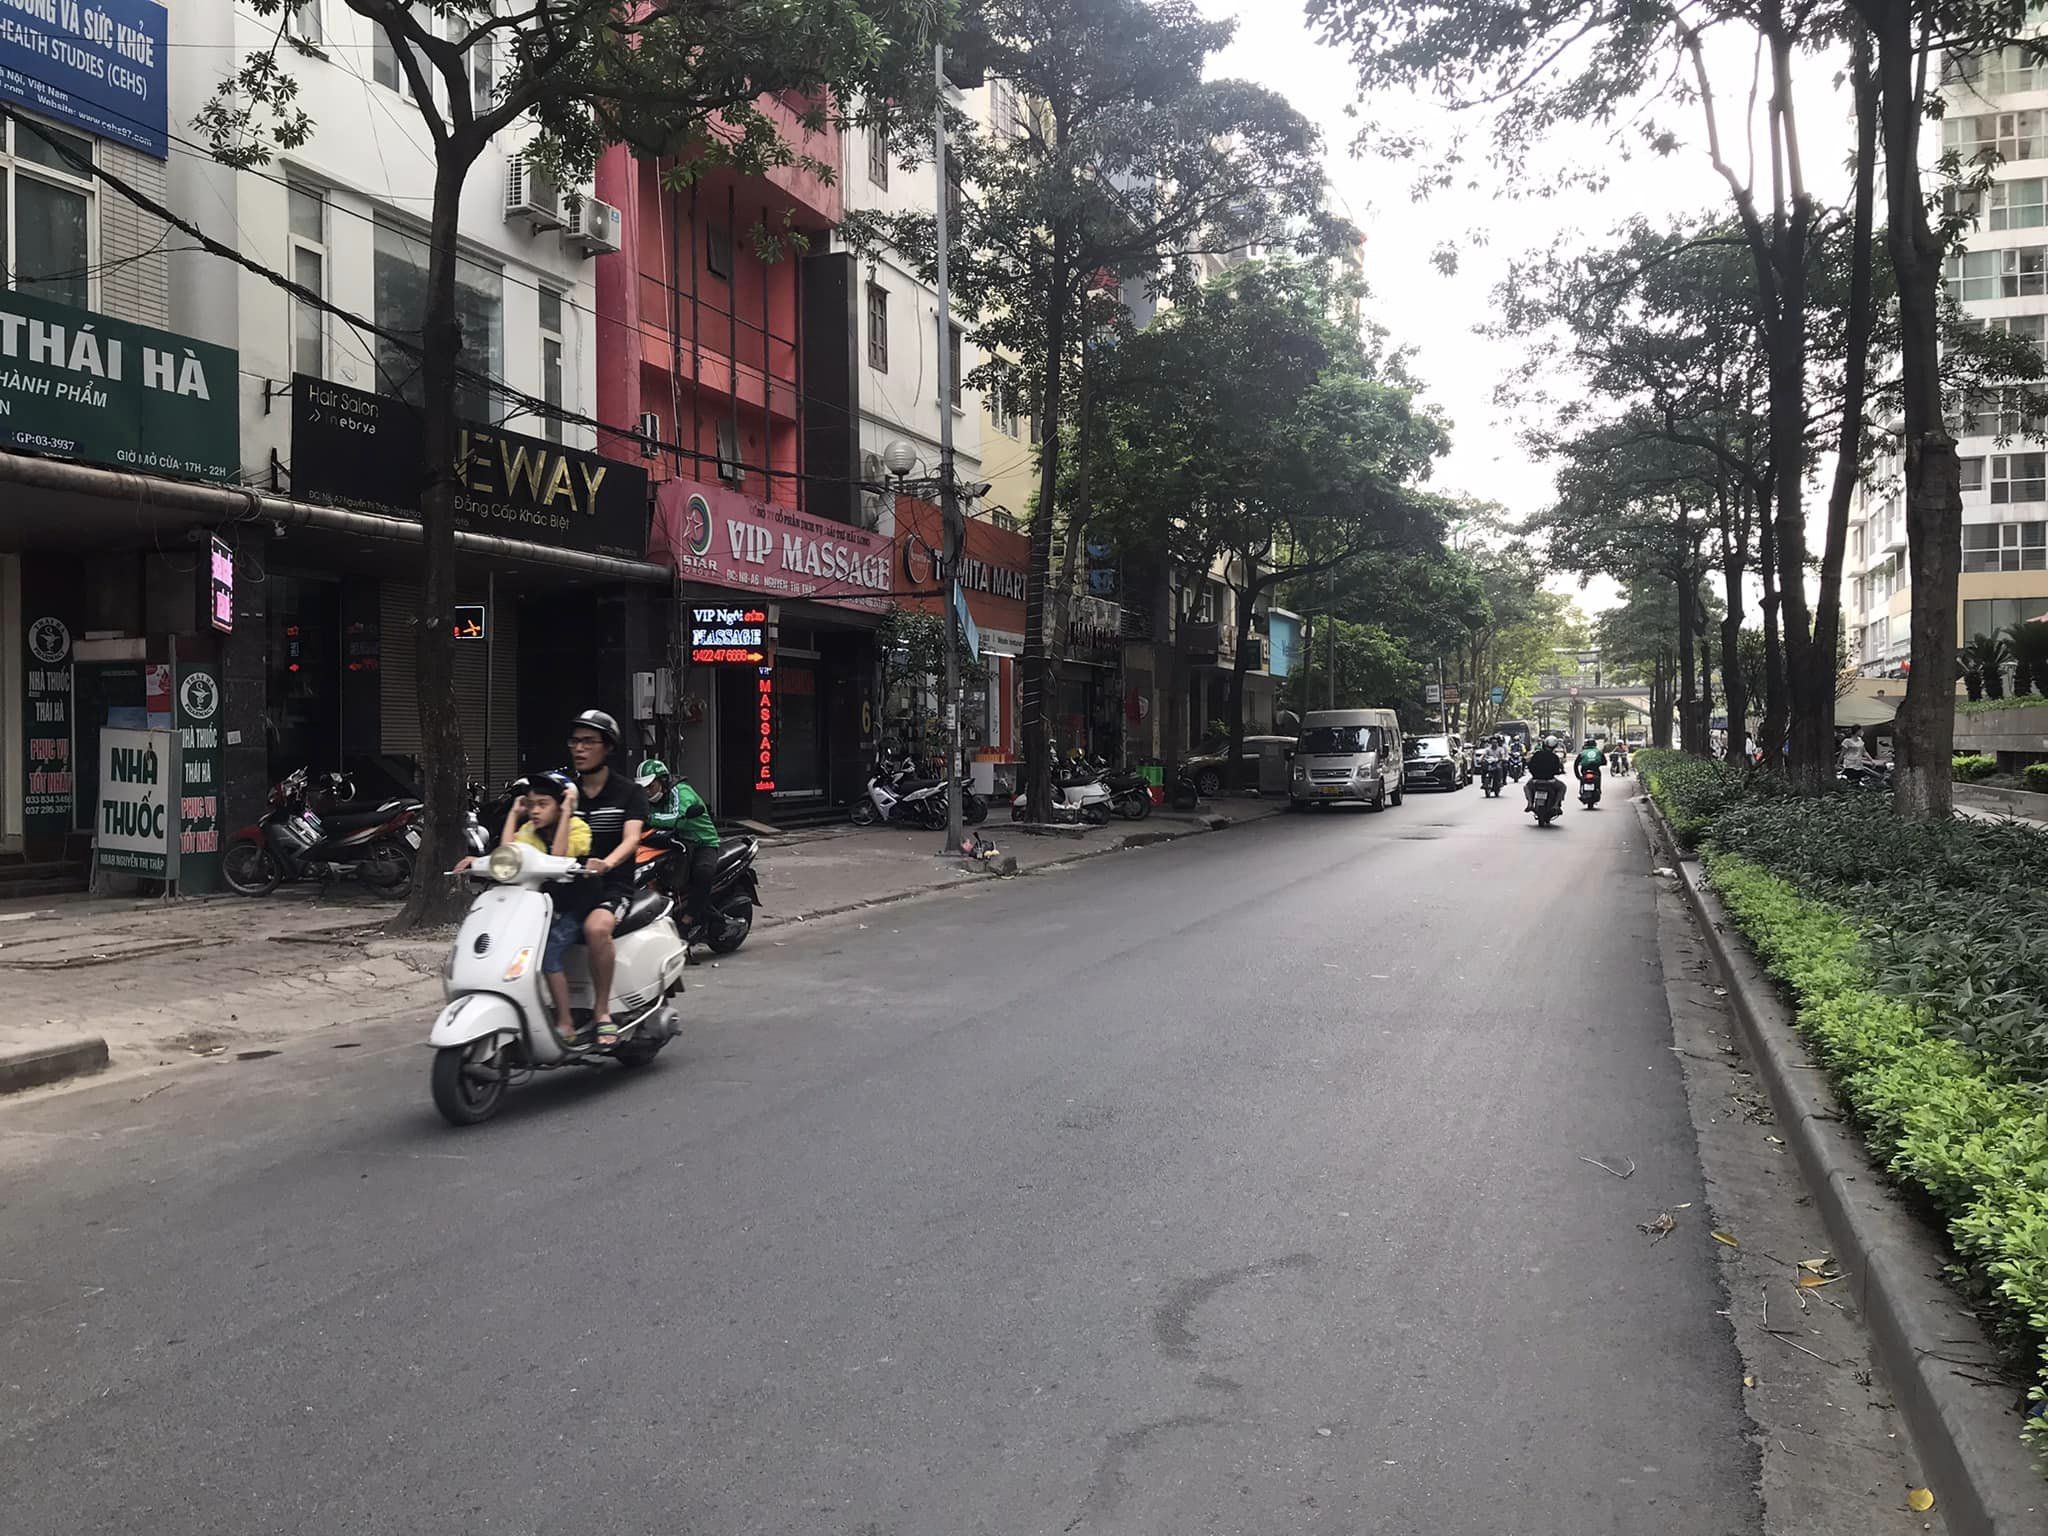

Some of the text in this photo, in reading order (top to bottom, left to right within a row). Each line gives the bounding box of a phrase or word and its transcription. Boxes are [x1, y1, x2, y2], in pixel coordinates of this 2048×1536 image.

[84, 5, 113, 49] SỨC
[118, 20, 154, 68] KHỎE
[51, 39, 104, 79] STUDIES
[108, 63, 147, 101] (CEHS)
[28, 78, 46, 93] Việt
[48, 86, 69, 102] Nam
[0, 311, 210, 400] THÁI HÀ
[55, 380, 107, 408] PHẨM
[309, 384, 379, 419] Hair Salon
[185, 462, 201, 474] 17H
[209, 465, 226, 477] 22H
[491, 502, 517, 521] Cấp
[519, 507, 548, 526] Khác
[550, 513, 570, 532] Biệt
[682, 555, 718, 571] STAR
[726, 518, 890, 591] VIP MASSAGE
[992, 567, 1028, 601] MART
[693, 609, 715, 622] VIP
[693, 629, 761, 645] MASSAGE
[195, 721, 217, 748] THUỐC
[759, 679, 771, 778] MASSAGE
[111, 742, 158, 785] NHÀ
[185, 760, 212, 783] THÁI HÀ
[103, 790, 165, 840] THUỐC
[181, 796, 216, 823] PHỤC VỤ
[180, 823, 218, 854] TỐT NHẤT
